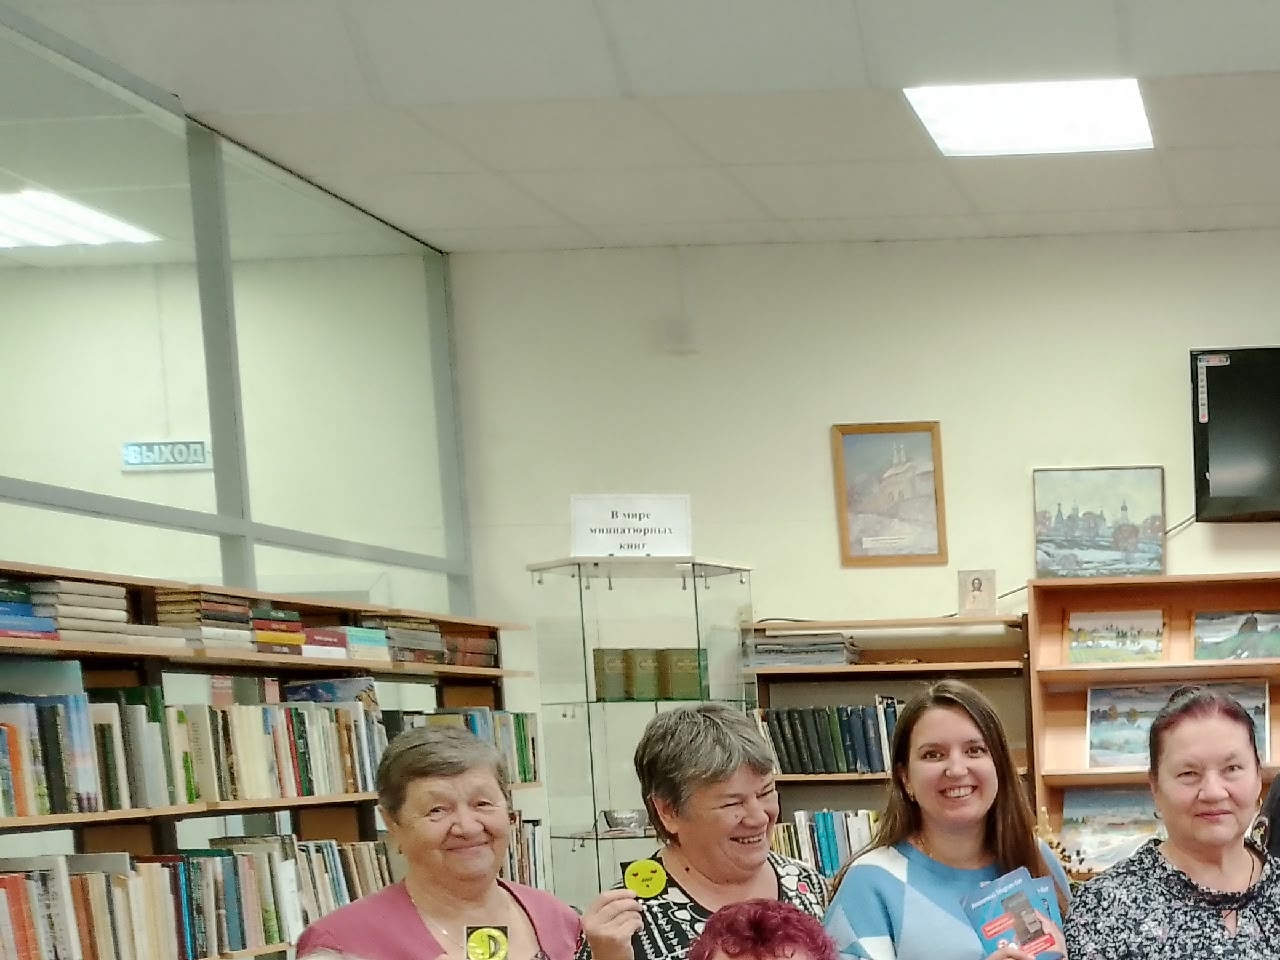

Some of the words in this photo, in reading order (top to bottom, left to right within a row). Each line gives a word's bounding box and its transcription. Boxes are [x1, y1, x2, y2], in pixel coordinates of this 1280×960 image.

[127, 443, 205, 464] ВЫХОД
[611, 510, 619, 519] В
[623, 512, 651, 521] мире
[589, 527, 673, 536] миниатюрных
[619, 542, 647, 550] книг
